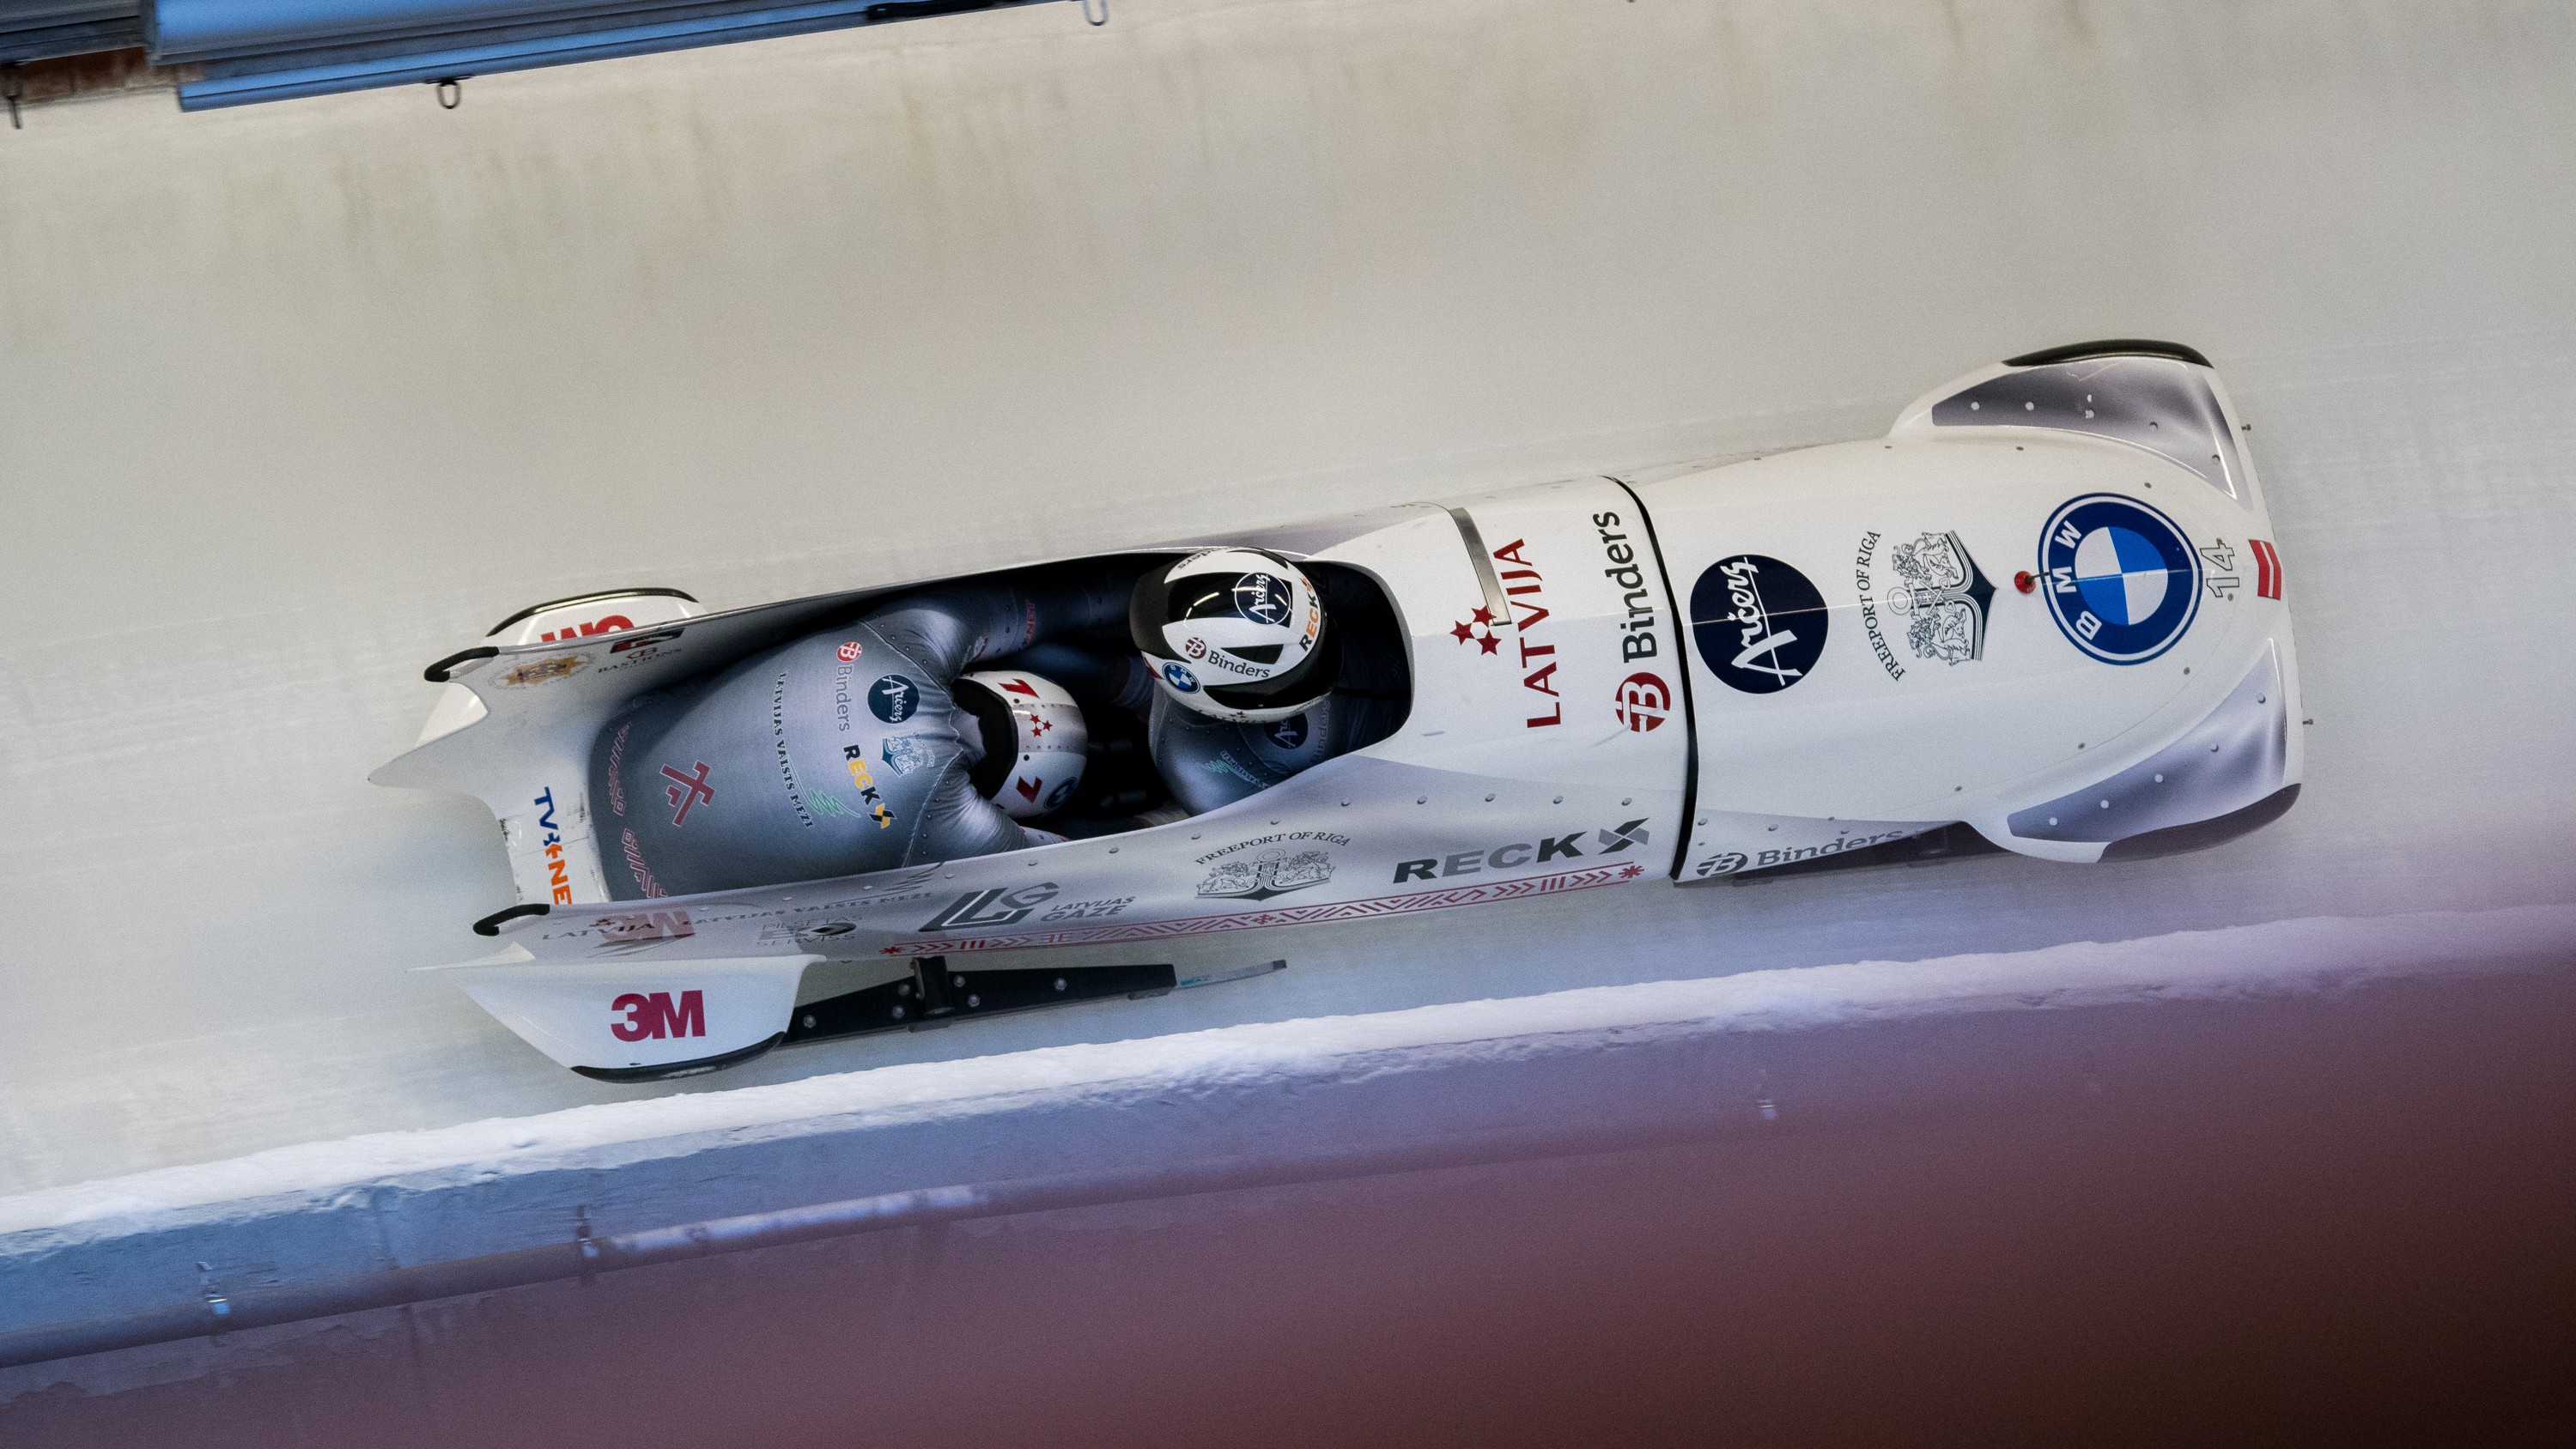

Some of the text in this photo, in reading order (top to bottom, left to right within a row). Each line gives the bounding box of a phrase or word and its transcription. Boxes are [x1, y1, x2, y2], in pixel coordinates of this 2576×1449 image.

[1177, 547, 1230, 570] nders
[2054, 520, 2103, 640] BMW
[2199, 543, 2239, 597] 14
[1592, 512, 1658, 663] Binders
[1856, 530, 1906, 682] FREEPORT OF RIGA
[1299, 593, 1319, 652] RECK
[1493, 538, 1561, 728] LATVIJA
[1170, 665, 1196, 682] BMW
[1208, 649, 1270, 678] Binders
[773, 671, 787, 736] LATVIJAS
[835, 664, 854, 732] Binders
[776, 739, 795, 791] VALSTS
[843, 744, 881, 806] RECK
[1194, 832, 1351, 865] FREEPORT OF RIGA
[1393, 831, 1588, 883] RECK
[1757, 830, 1903, 867] Binders
[1051, 895, 1136, 912] LATVIJAS
[542, 922, 655, 940] LATVIJA
[610, 989, 706, 1042] 3M
